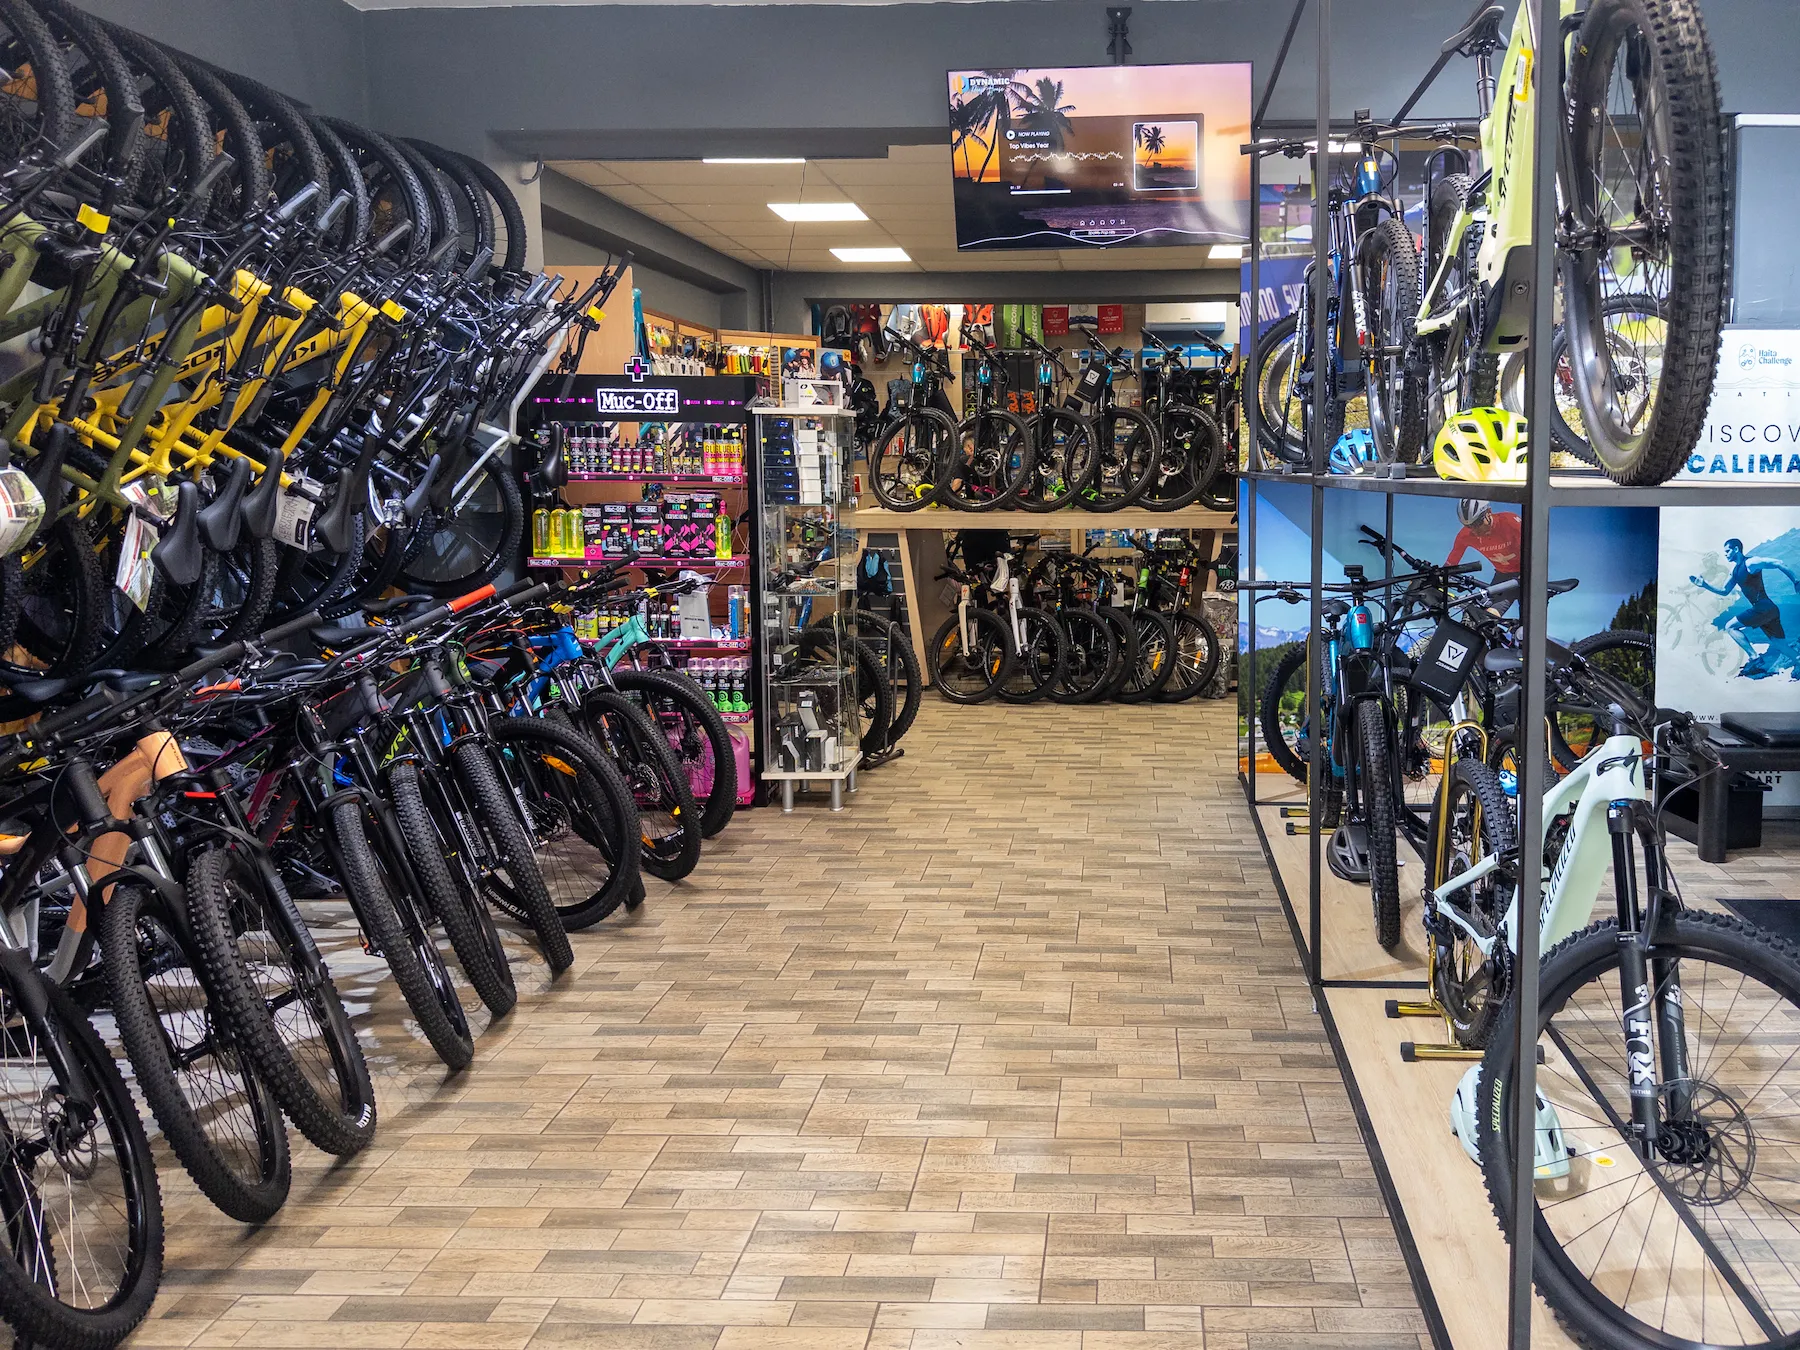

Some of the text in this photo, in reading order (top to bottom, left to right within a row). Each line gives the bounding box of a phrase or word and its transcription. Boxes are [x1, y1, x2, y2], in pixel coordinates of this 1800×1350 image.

[970, 77, 1010, 86] DYNAMIC
[1758, 357, 1793, 366] Challenge
[601, 392, 675, 411] Muc-Off
[1709, 424, 1800, 443] ISCOV
[1626, 1019, 1657, 1086] FOX
[1492, 1078, 1503, 1133] SPECIALIZED
